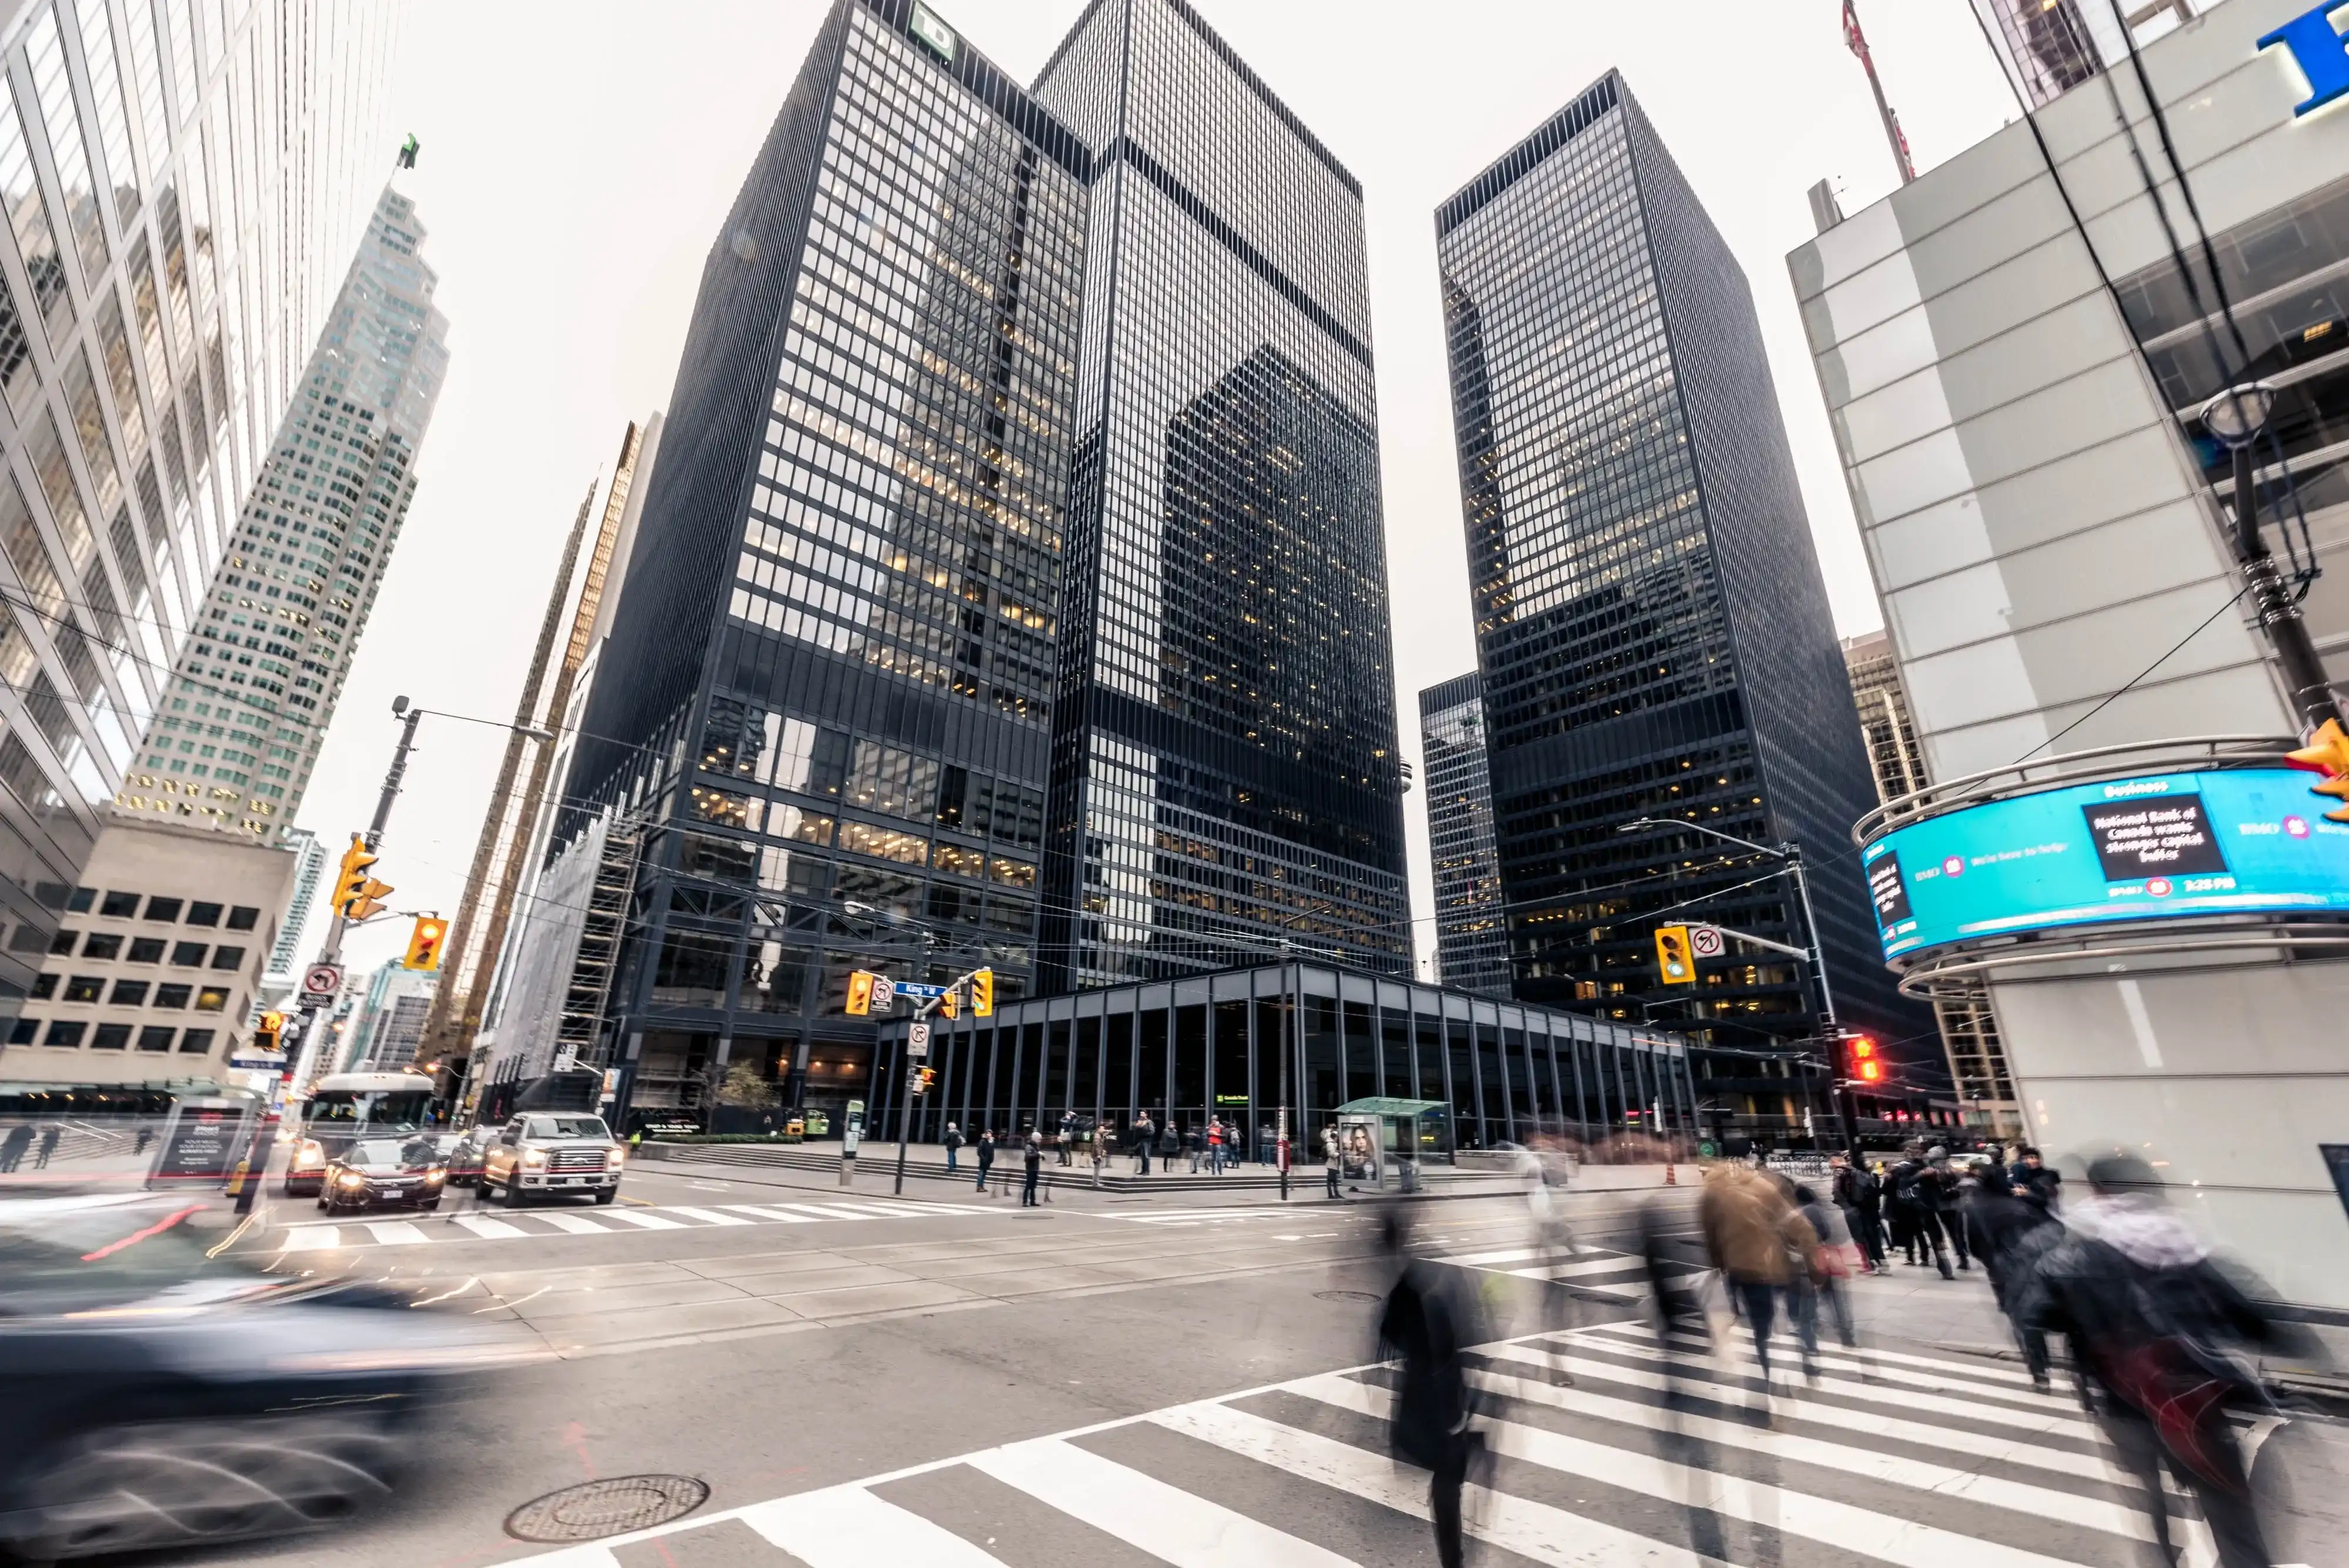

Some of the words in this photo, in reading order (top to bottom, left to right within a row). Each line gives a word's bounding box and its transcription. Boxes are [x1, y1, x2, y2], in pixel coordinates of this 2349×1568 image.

[918, 9, 950, 49] TD
[2104, 782, 2168, 798] Business
[2094, 812, 2148, 829] National
[2148, 809, 2182, 823] Bank
[2183, 807, 2197, 820] of
[2107, 825, 2153, 840] Canada
[2154, 822, 2194, 836] wants
[906, 984, 923, 996] King
